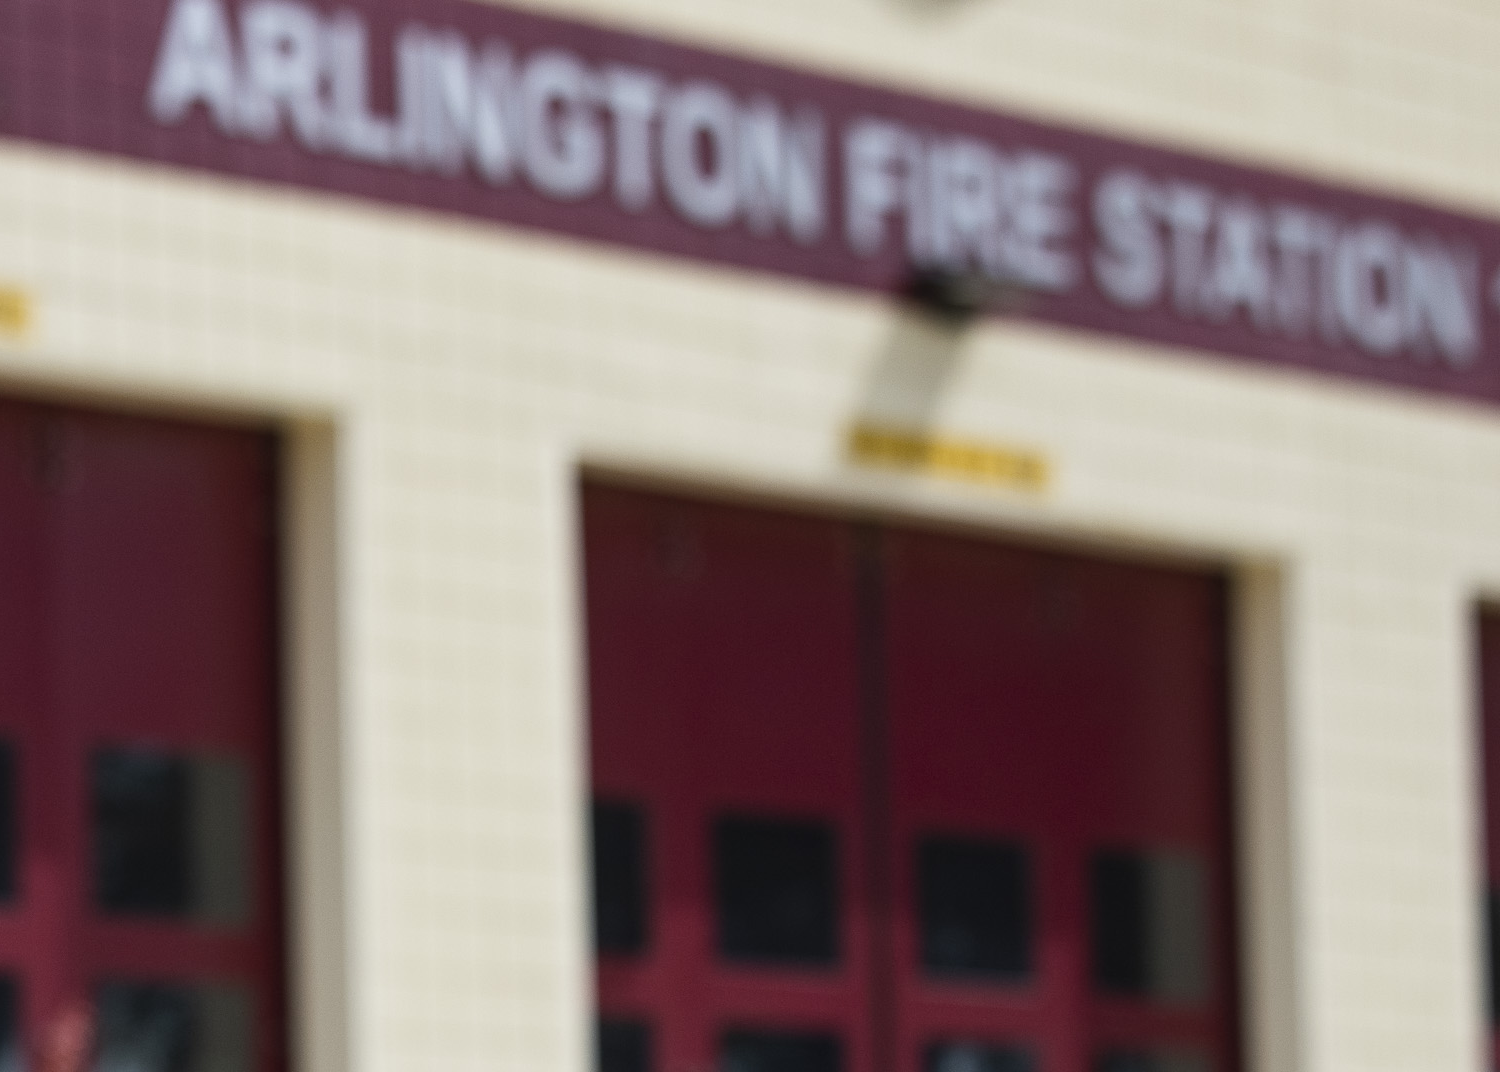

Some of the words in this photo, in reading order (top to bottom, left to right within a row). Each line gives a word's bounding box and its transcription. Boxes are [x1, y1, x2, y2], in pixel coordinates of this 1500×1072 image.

[150, 0, 826, 244] ARLINGTON
[844, 122, 1077, 290] FIRE
[1093, 168, 1481, 364] STATION
